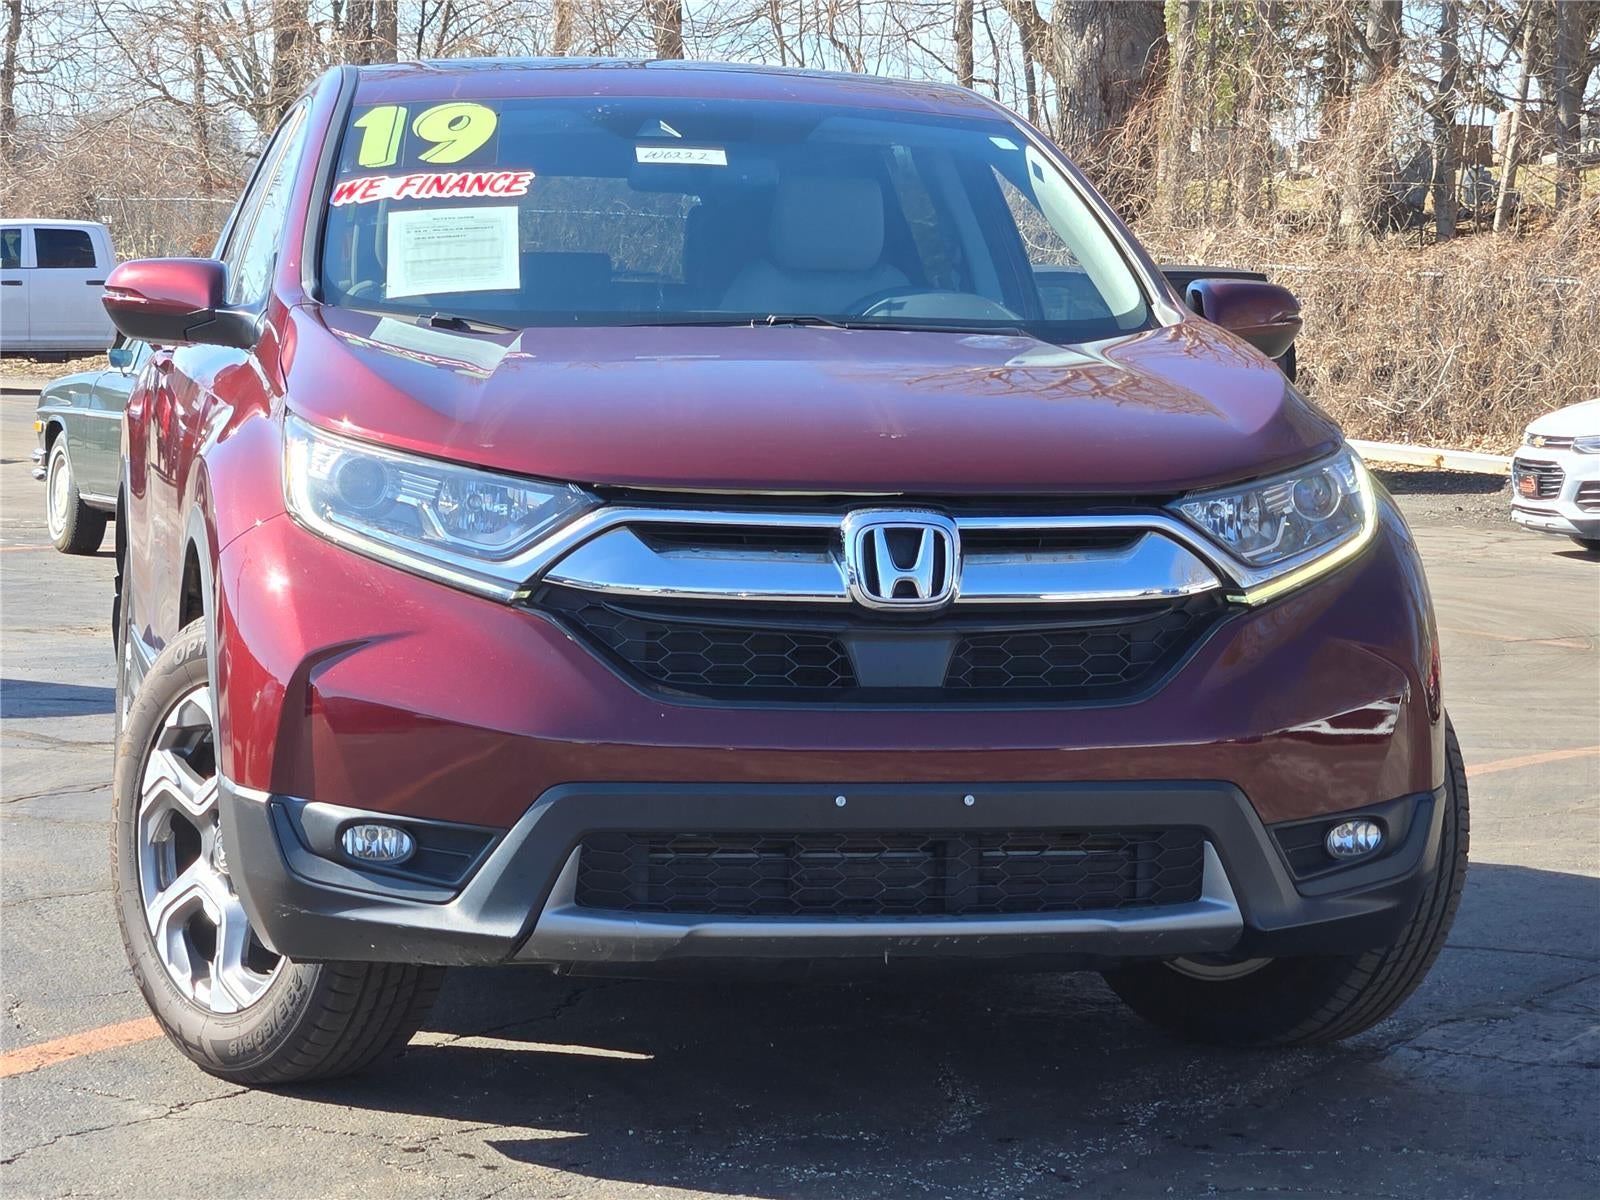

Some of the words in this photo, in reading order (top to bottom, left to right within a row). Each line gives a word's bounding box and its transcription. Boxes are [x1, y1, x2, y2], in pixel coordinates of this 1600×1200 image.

[354, 103, 497, 168] 19
[334, 177, 386, 202] WE
[396, 172, 531, 196] FINANCE
